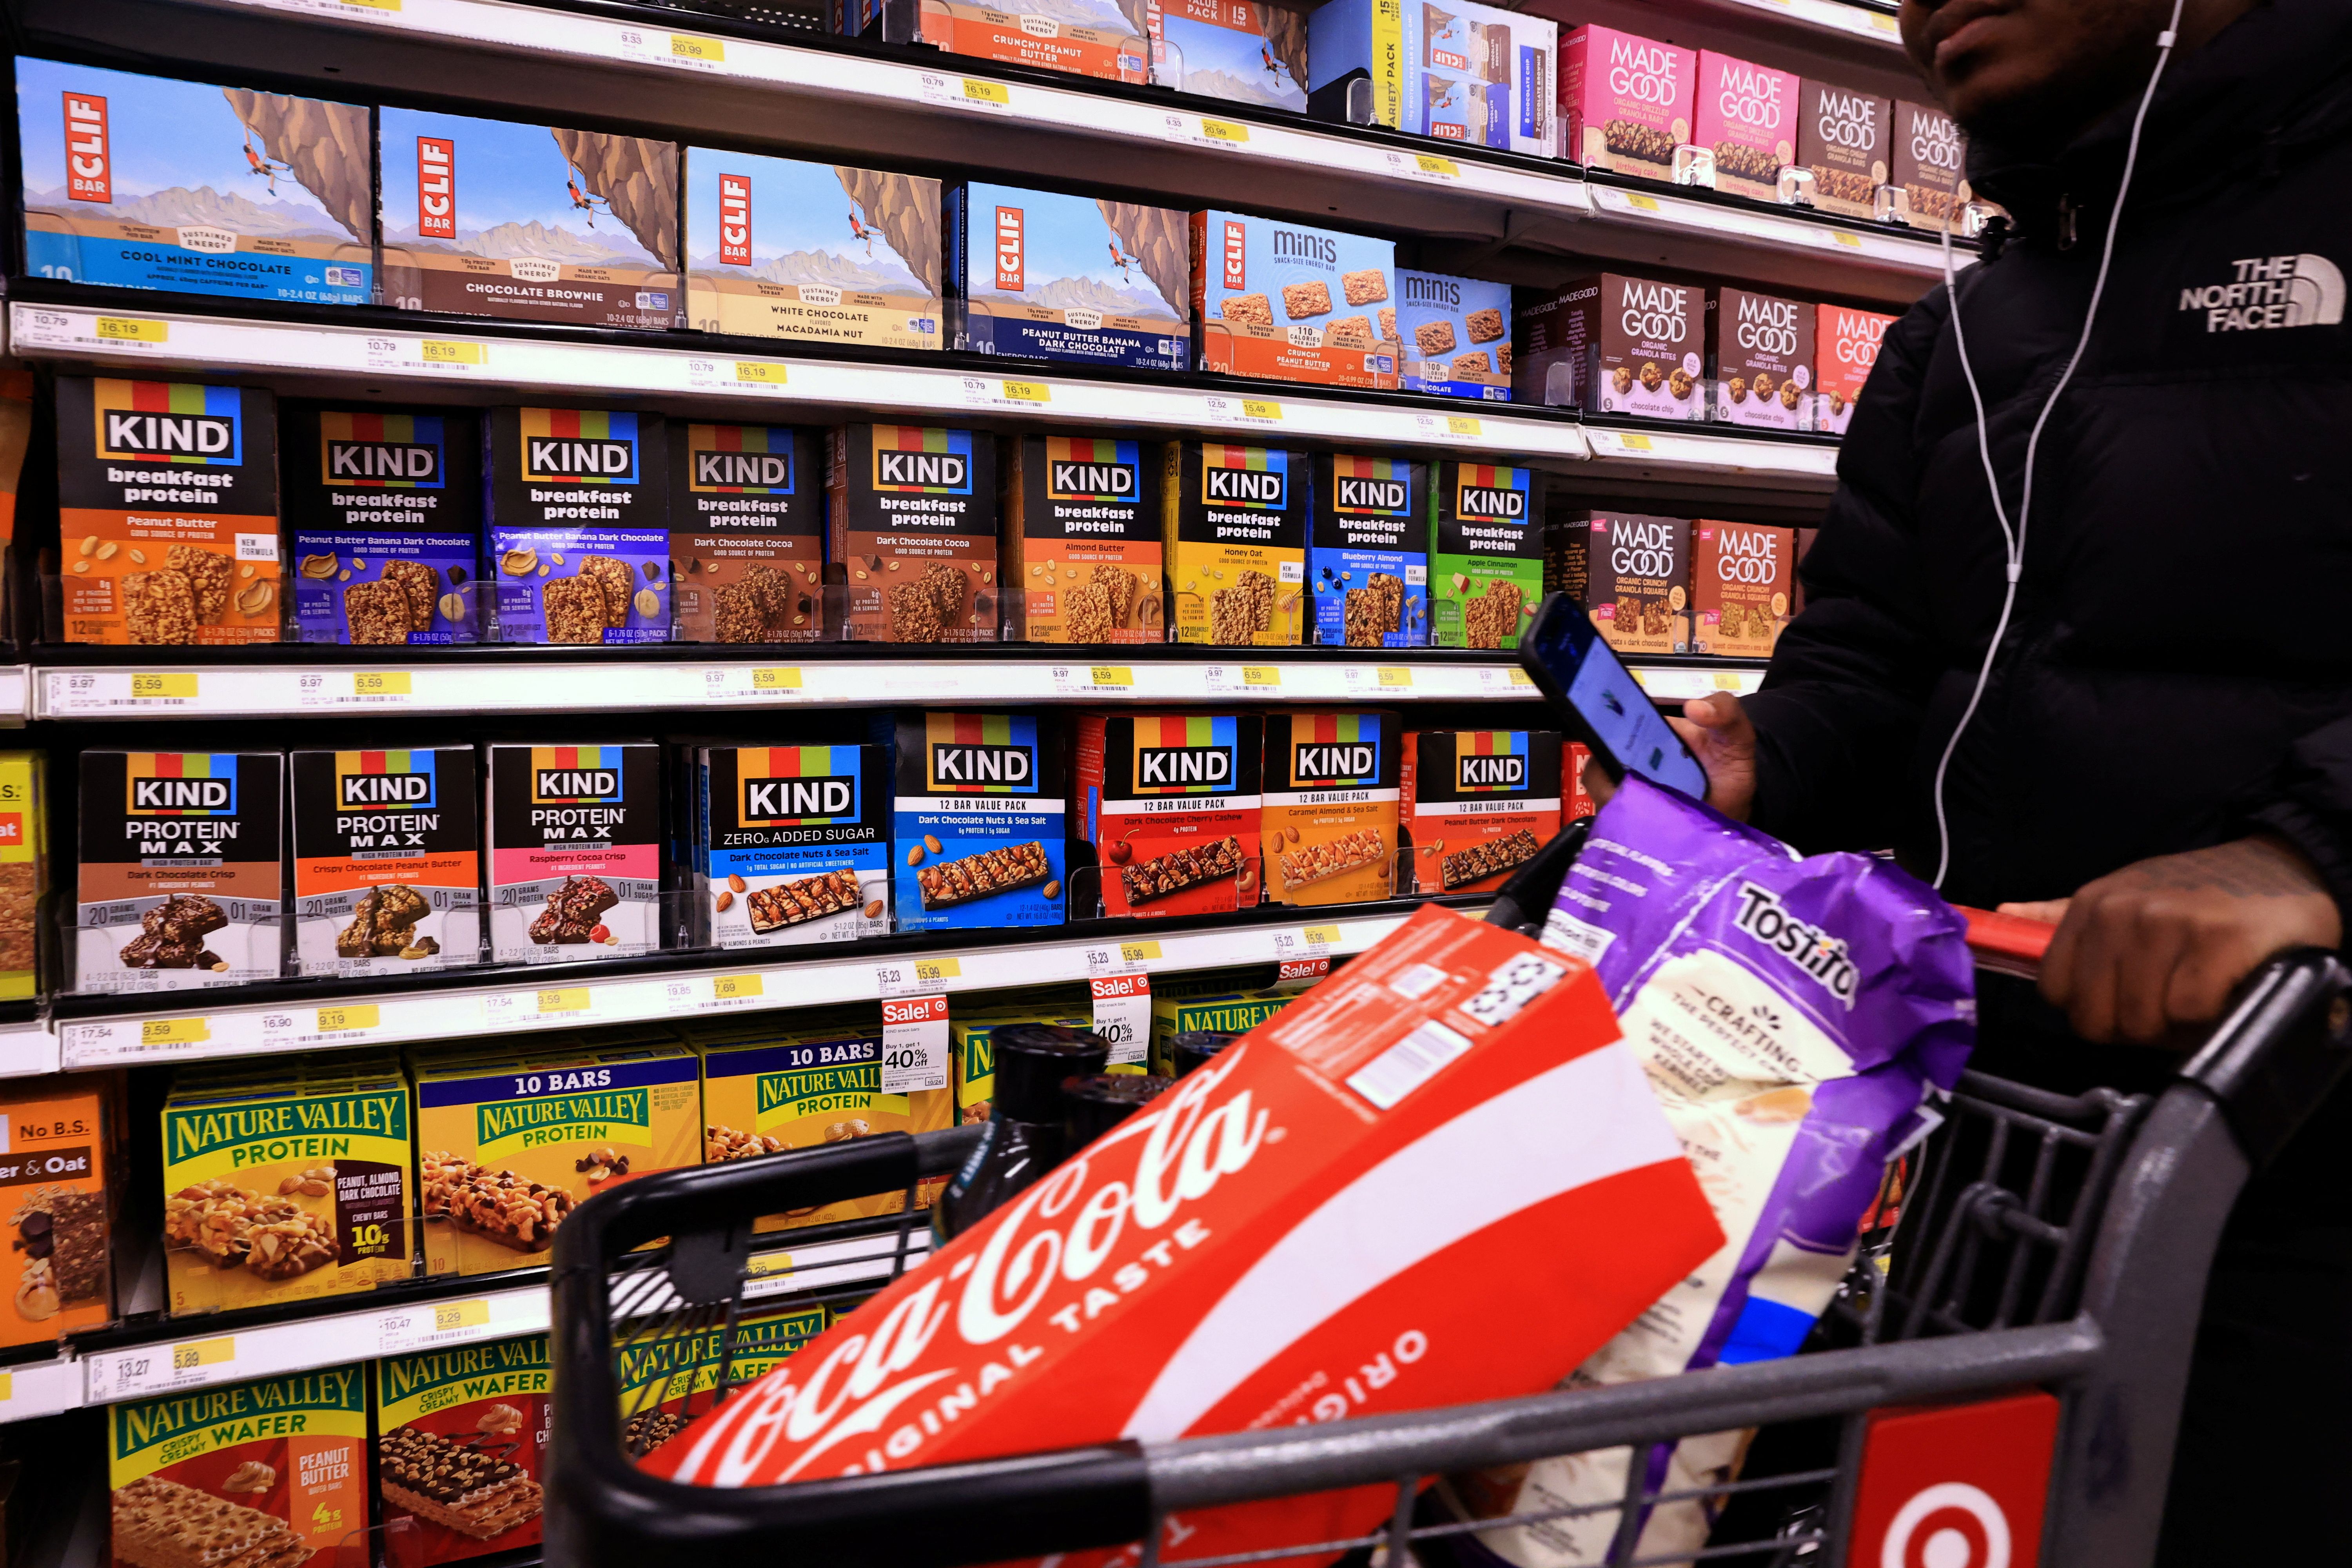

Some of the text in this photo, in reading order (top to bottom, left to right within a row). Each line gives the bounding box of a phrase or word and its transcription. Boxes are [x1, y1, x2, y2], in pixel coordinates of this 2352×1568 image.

[1188, 4, 1218, 20] PACK
[1233, 5, 1246, 20] 15
[672, 44, 702, 55] 20.99
[993, 34, 1082, 58] CRUNCHY PEANUT
[1020, 49, 1058, 63] BUTTER
[1610, 37, 1677, 80] MADE
[965, 85, 990, 96] 16.19
[1610, 67, 1676, 106] GOOD
[1613, 97, 1670, 116] ORGANIC DRIZZLED
[69, 99, 103, 179] CLIF
[1616, 161, 1658, 177] birthday cake
[73, 179, 106, 193] BAR
[724, 180, 747, 245] CLIF
[724, 246, 747, 258] BAR
[1226, 225, 1243, 273] CLIF
[1274, 229, 1337, 263] minis
[121, 251, 162, 263] COOL
[167, 256, 200, 267] MINT
[206, 259, 291, 275] CHOCOLATE
[1274, 256, 1336, 272] SNACK-SIZE ENERGY BAR
[2232, 256, 2298, 282] THE
[802, 287, 838, 297] SUSTAINED
[806, 295, 835, 303] ENERGY
[1622, 281, 1687, 317] MADE
[2178, 279, 2290, 310] NORTH
[771, 306, 869, 322] WHITE CHOCOLATE
[2207, 303, 2287, 332] FACE
[777, 324, 863, 339] MACADAMIA NUT
[1621, 309, 1686, 343] GOOD
[1631, 348, 1677, 361] GRANOLA BITES
[1641, 341, 1668, 352] ORGANIC
[1136, 358, 1149, 366] 10-2.4
[1158, 360, 1169, 368] (68g)
[1005, 385, 1030, 395] 16.19
[1207, 400, 1227, 409] 12.52
[1244, 404, 1266, 414] 15.49
[1631, 401, 1674, 415] chocolate chip
[108, 414, 229, 453] KIND
[333, 446, 434, 477] KIND
[882, 454, 964, 485] KIND
[108, 467, 234, 488] breakfast
[1210, 471, 1280, 501] KIND
[125, 489, 219, 505] protein
[127, 516, 218, 529] Peanut Butter
[426, 538, 470, 546] Chocolate
[877, 536, 970, 548] Dark Chocolate Cocoa
[1612, 519, 1673, 551] MADE
[241, 548, 274, 557] FORMULA
[1225, 548, 1262, 558] Honey Oat
[1342, 552, 1403, 563] Blueberry Almond
[1467, 559, 1517, 569] Apple Cinnamon
[1612, 547, 1673, 577] GOOD
[1616, 576, 1668, 587] ORGANIC CRUNCHY
[1615, 585, 1668, 596] GRANOLA SQUARES
[1093, 671, 1111, 679] 6.59
[937, 750, 1028, 782] KIND
[136, 781, 227, 807] KIND
[750, 782, 850, 815] KIND
[940, 800, 1026, 811] 12 BAR VALUE PACK
[1124, 812, 1243, 826] Dark Chocolate Cherry Cashew
[126, 822, 237, 839] PROTEIN
[773, 830, 822, 843] ADDED
[826, 828, 875, 840] SUGAR
[530, 852, 626, 864] Raspberry Cocoa Crisp
[127, 870, 235, 880] Dark Chocolate Crisp
[877, 970, 900, 983] 15.23
[917, 967, 940, 980] 15.99
[884, 1002, 929, 1022] Sale!
[1706, 996, 1802, 1073] CRAFTING
[515, 1069, 611, 1095] 10 BARS
[20, 1124, 46, 1138] No
[175, 1096, 399, 1159] NATURE VALLEY
[233, 1138, 350, 1167] PROTEIN
[338, 1172, 401, 1189] PEANUT, ALMOND,
[339, 1184, 401, 1201] DARK CHOCOLATE
[352, 1224, 390, 1247] 10g
[674, 1043, 1270, 1485] Coca-Cola
[842, 1218, 1211, 1477] IGINAL TASTE
[118, 1359, 149, 1379] 13.27
[174, 1352, 200, 1369] 5.89
[126, 1369, 353, 1451] NATURE VALLEY
[211, 1414, 307, 1446] WAFER
[299, 1447, 350, 1472] PEANUT
[300, 1464, 349, 1486] BUTTER
